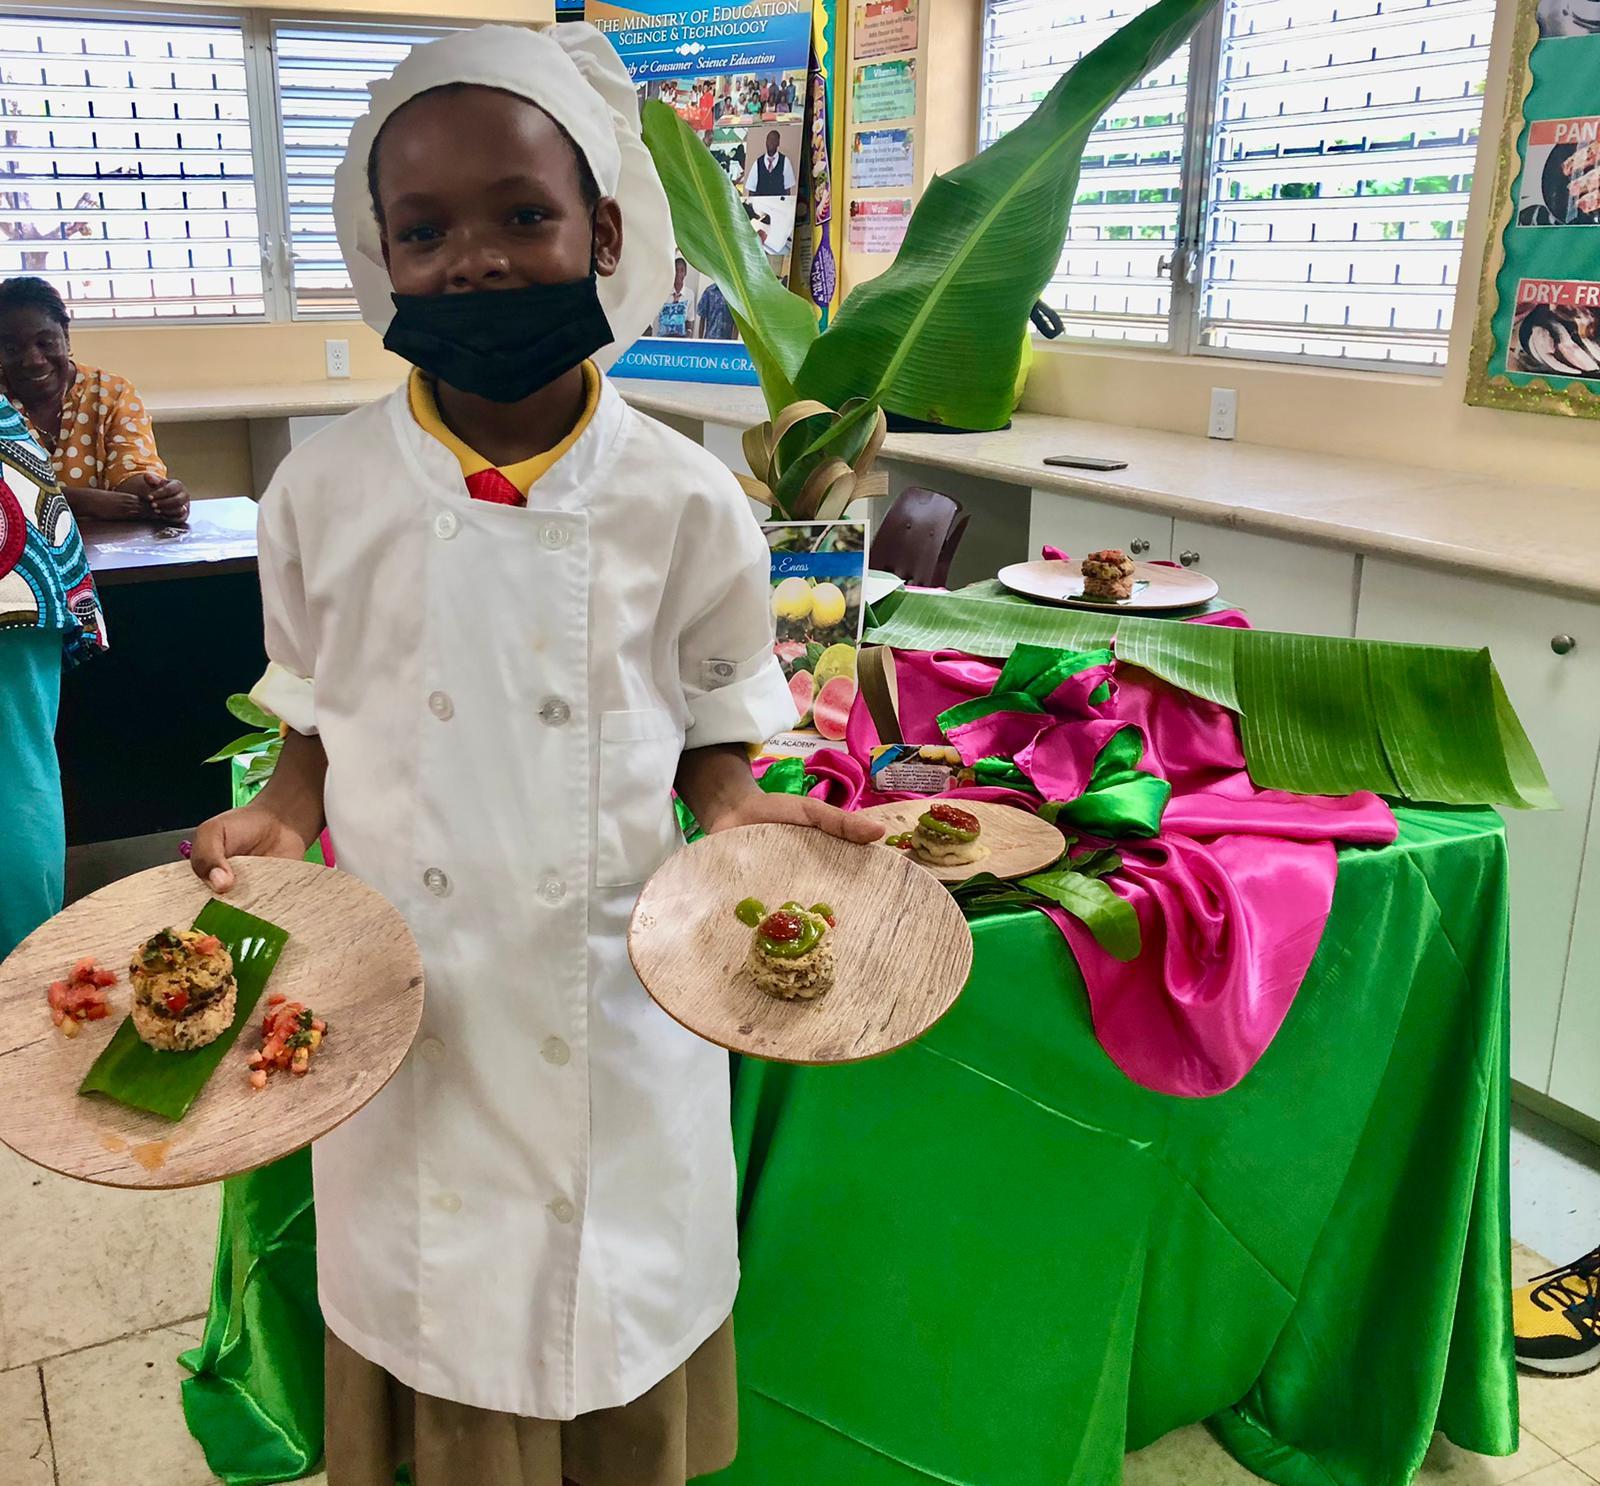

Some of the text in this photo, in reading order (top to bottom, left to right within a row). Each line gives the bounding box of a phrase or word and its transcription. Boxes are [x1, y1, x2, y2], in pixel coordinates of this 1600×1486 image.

[594, 0, 800, 33] THE MINISTRY OF EDUCATION
[619, 20, 768, 46] SCIENCE & TECHNOLOGY
[639, 59, 649, 74] &
[650, 59, 693, 74] Consumer
[696, 56, 728, 70] Science
[729, 52, 776, 67] Education
[1554, 121, 1599, 145] PAN
[1523, 283, 1569, 304] DRY-
[626, 352, 718, 369] CONSTRUCTION
[720, 357, 730, 370] &
[778, 556, 809, 573] Eneas
[781, 740, 817, 749] ACADEMY
